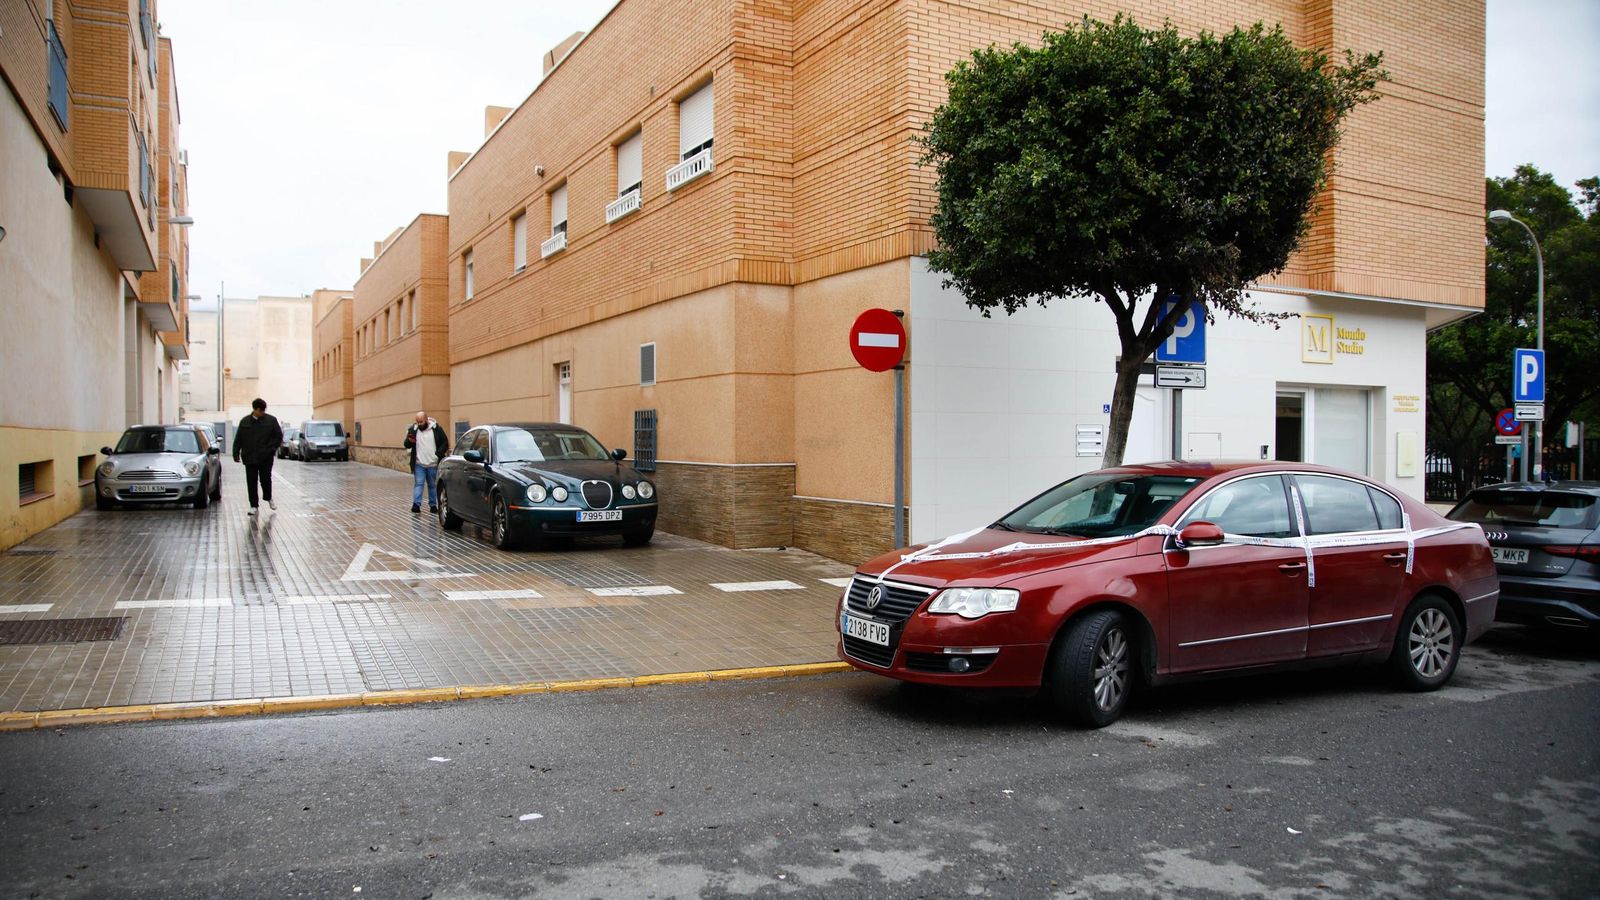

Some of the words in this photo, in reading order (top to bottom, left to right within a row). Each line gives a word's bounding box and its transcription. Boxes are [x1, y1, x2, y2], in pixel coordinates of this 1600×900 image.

[1166, 302, 1195, 355] P
[1336, 327, 1366, 341] Mondo
[1307, 324, 1328, 353] M
[1336, 341, 1364, 355] Studio
[1520, 354, 1539, 396] P
[582, 512, 603, 521] 7995
[605, 511, 620, 520] DPZ
[1502, 549, 1525, 561] MKR
[848, 618, 868, 638] 2138
[869, 624, 887, 643] FVB
